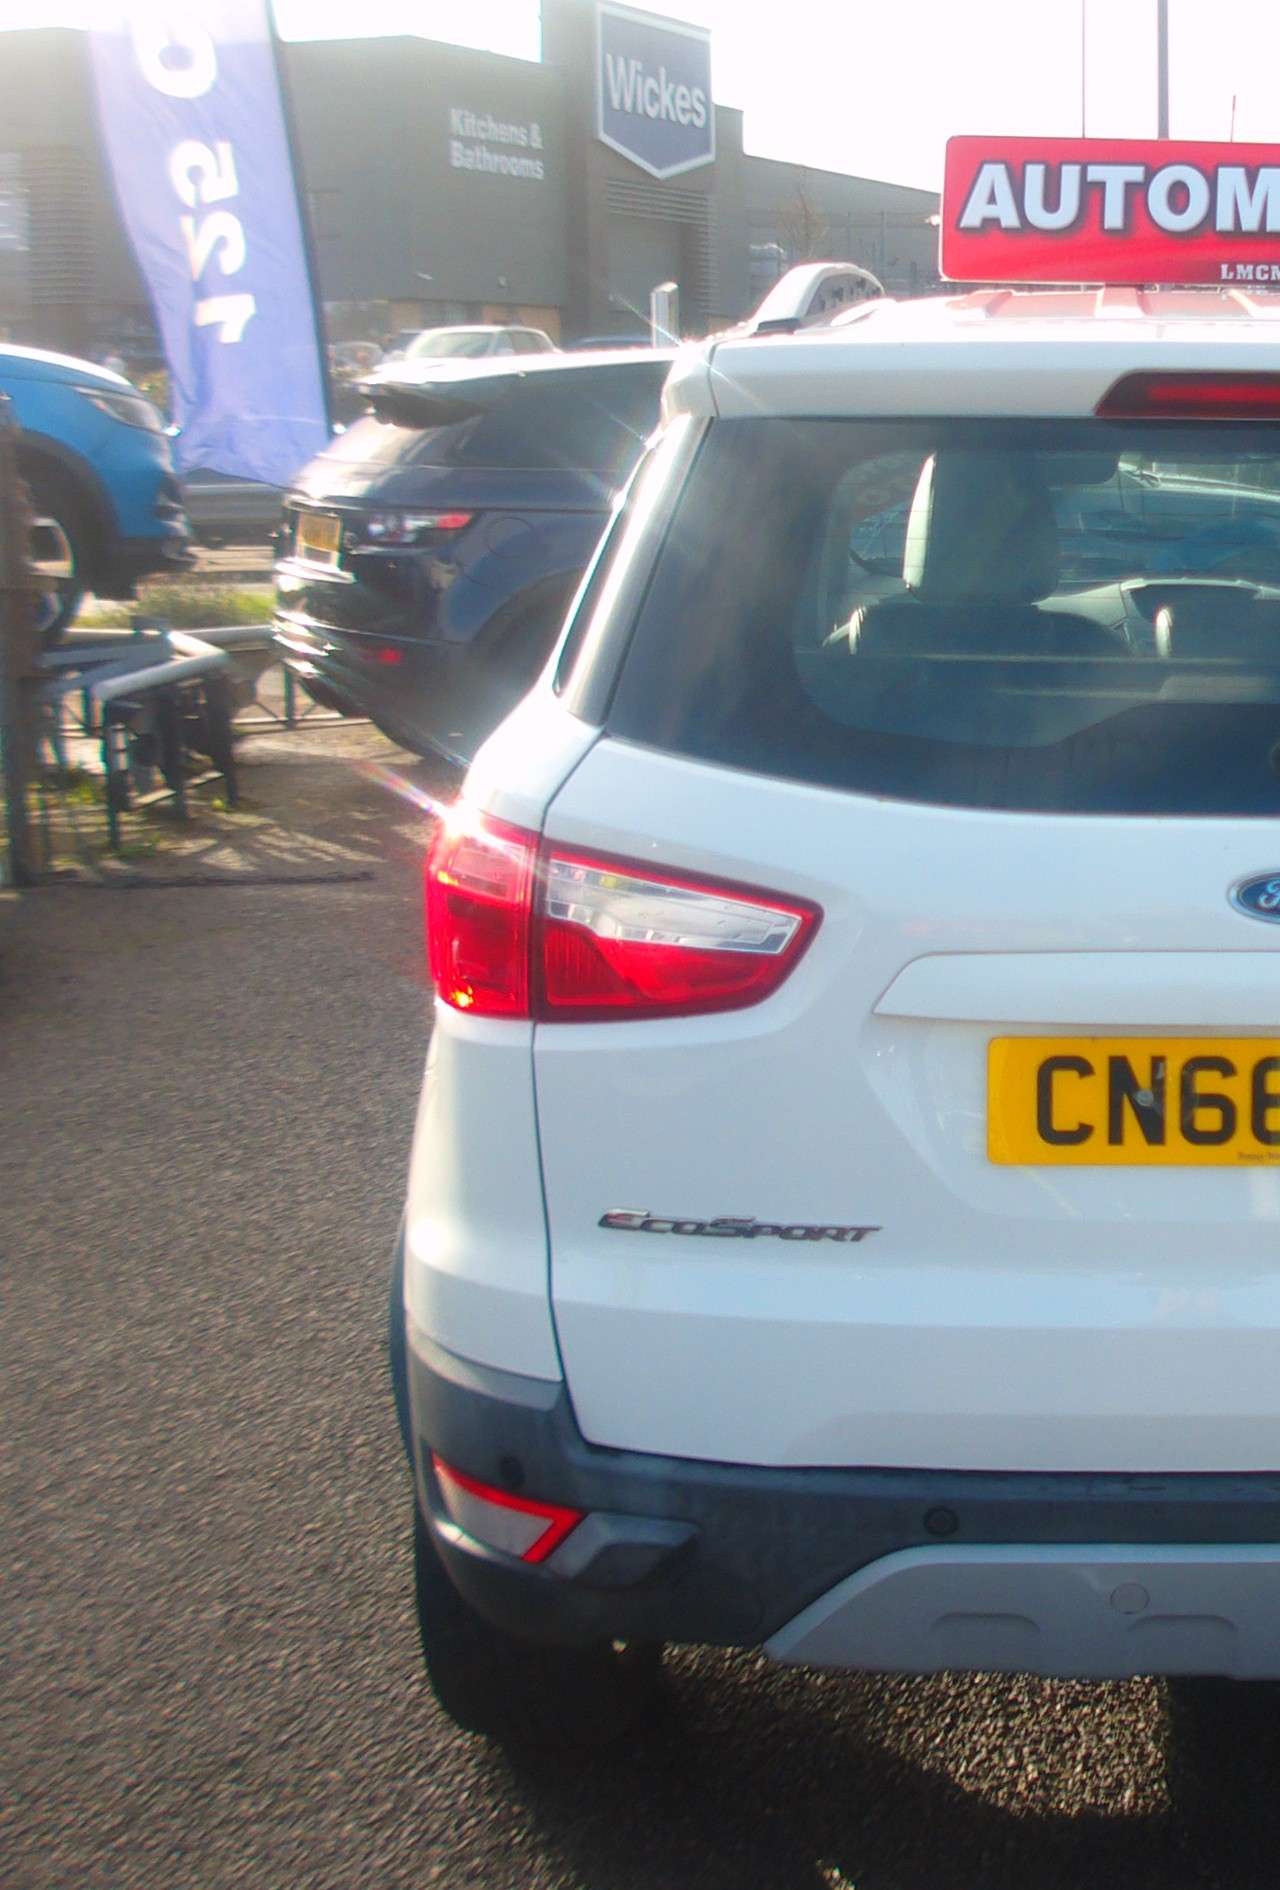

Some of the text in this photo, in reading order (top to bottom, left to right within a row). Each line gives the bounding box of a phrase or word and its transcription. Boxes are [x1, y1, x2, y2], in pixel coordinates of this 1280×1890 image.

[606, 53, 706, 128] Wickes
[450, 108, 544, 149] Kitchens &
[450, 140, 545, 180] Bathrooms
